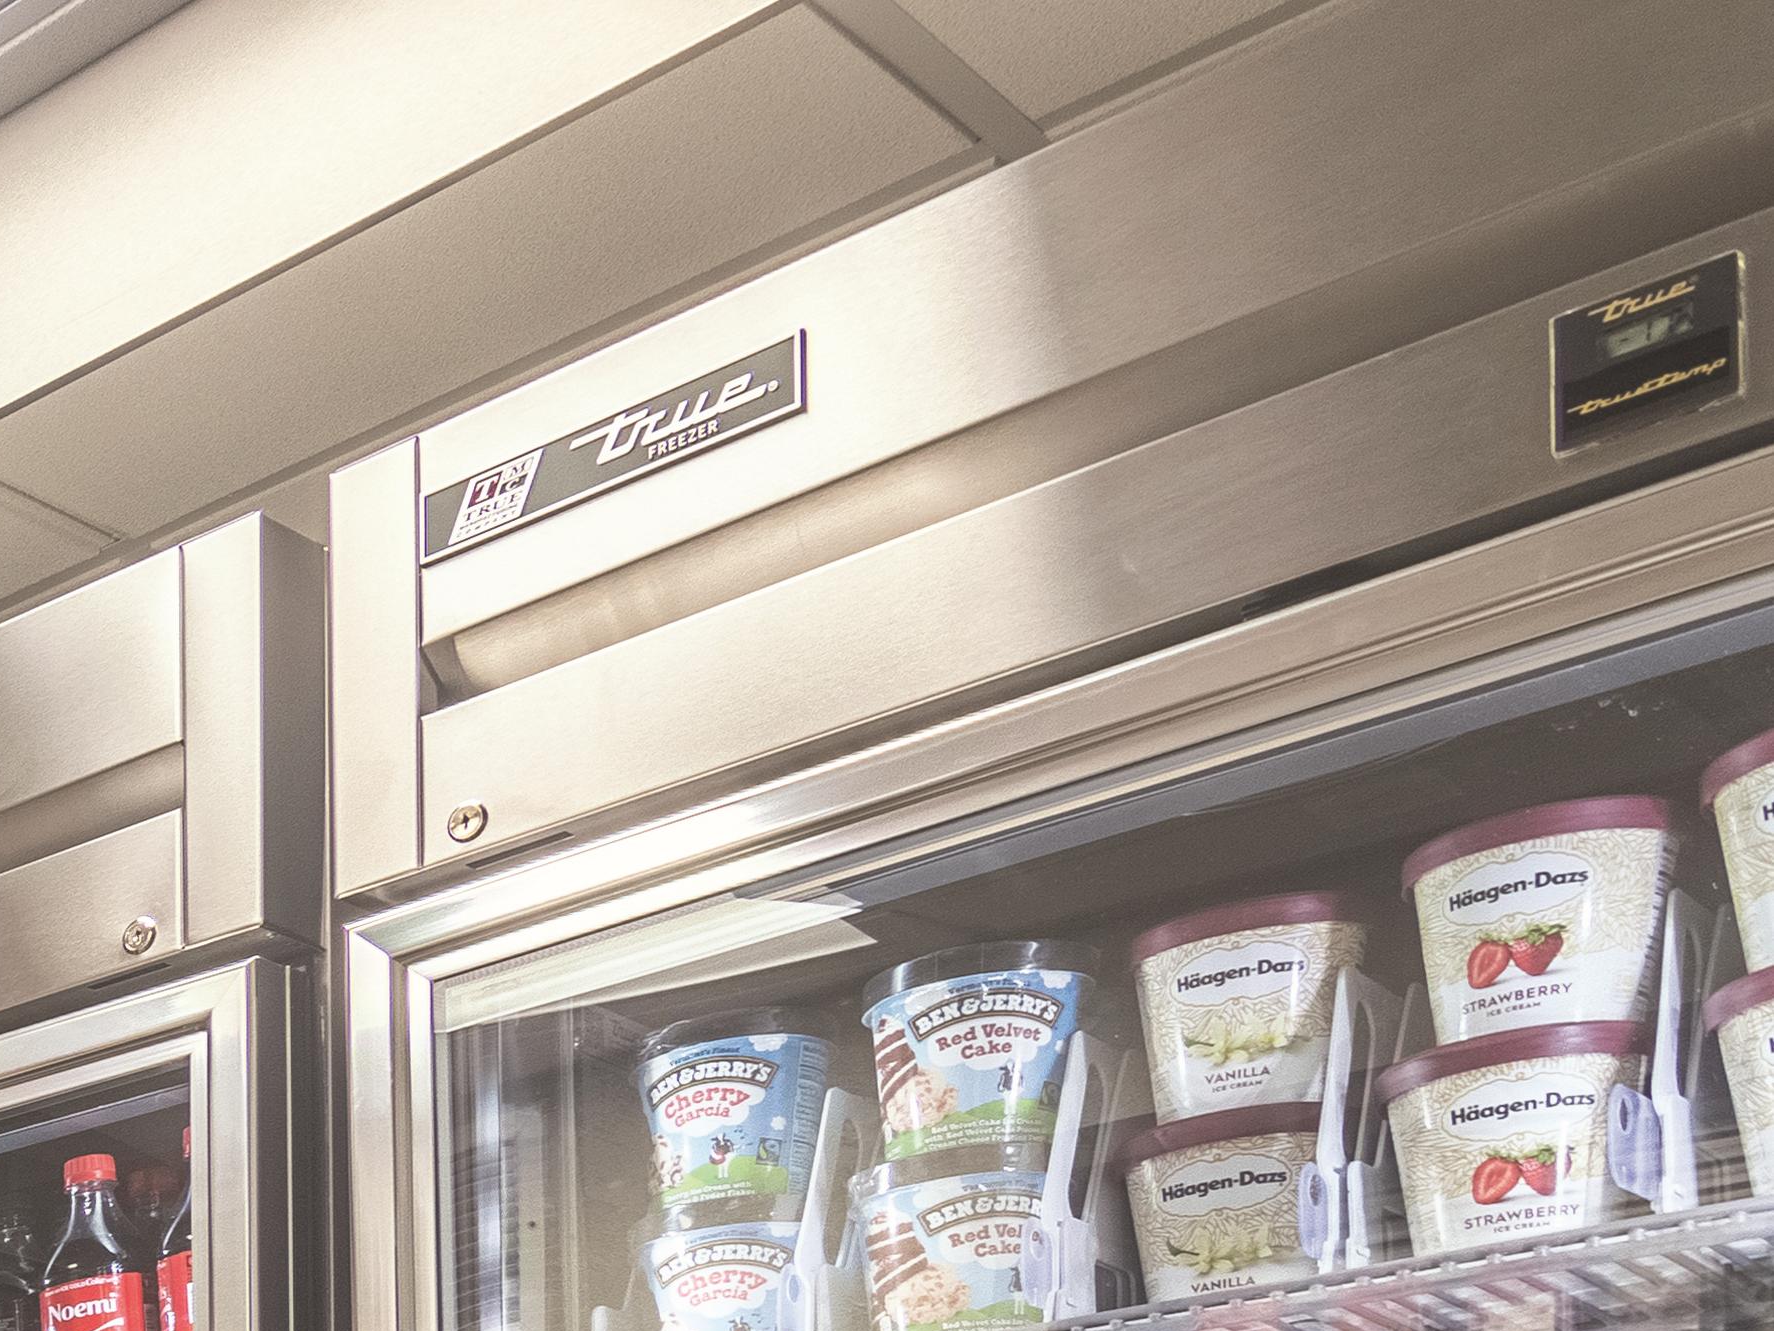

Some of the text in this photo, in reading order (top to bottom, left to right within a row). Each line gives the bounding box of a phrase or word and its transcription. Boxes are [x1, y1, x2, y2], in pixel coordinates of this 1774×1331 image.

[647, 420, 720, 459] FREEZER
[462, 491, 523, 523] TRUE
[1448, 866, 1589, 912] Häagen-Dazs
[1176, 958, 1305, 993] Häagen-Dazs
[1462, 982, 1573, 1015] STRAWBERRY
[936, 1022, 1041, 1051] Red Velvet
[960, 1039, 1013, 1060] Cake
[1205, 1065, 1271, 1085] VANILLA
[664, 1085, 751, 1119] Cherry
[674, 1103, 730, 1128] Garcia
[1450, 1090, 1596, 1127] Häagen-Dazs
[1161, 1170, 1288, 1203] Häagen-Dazs
[1464, 1204, 1580, 1231] STRAWBERRY
[677, 1268, 767, 1300] Cherry
[1191, 1275, 1256, 1293] VANILLA
[49, 1292, 117, 1322] Noemi
